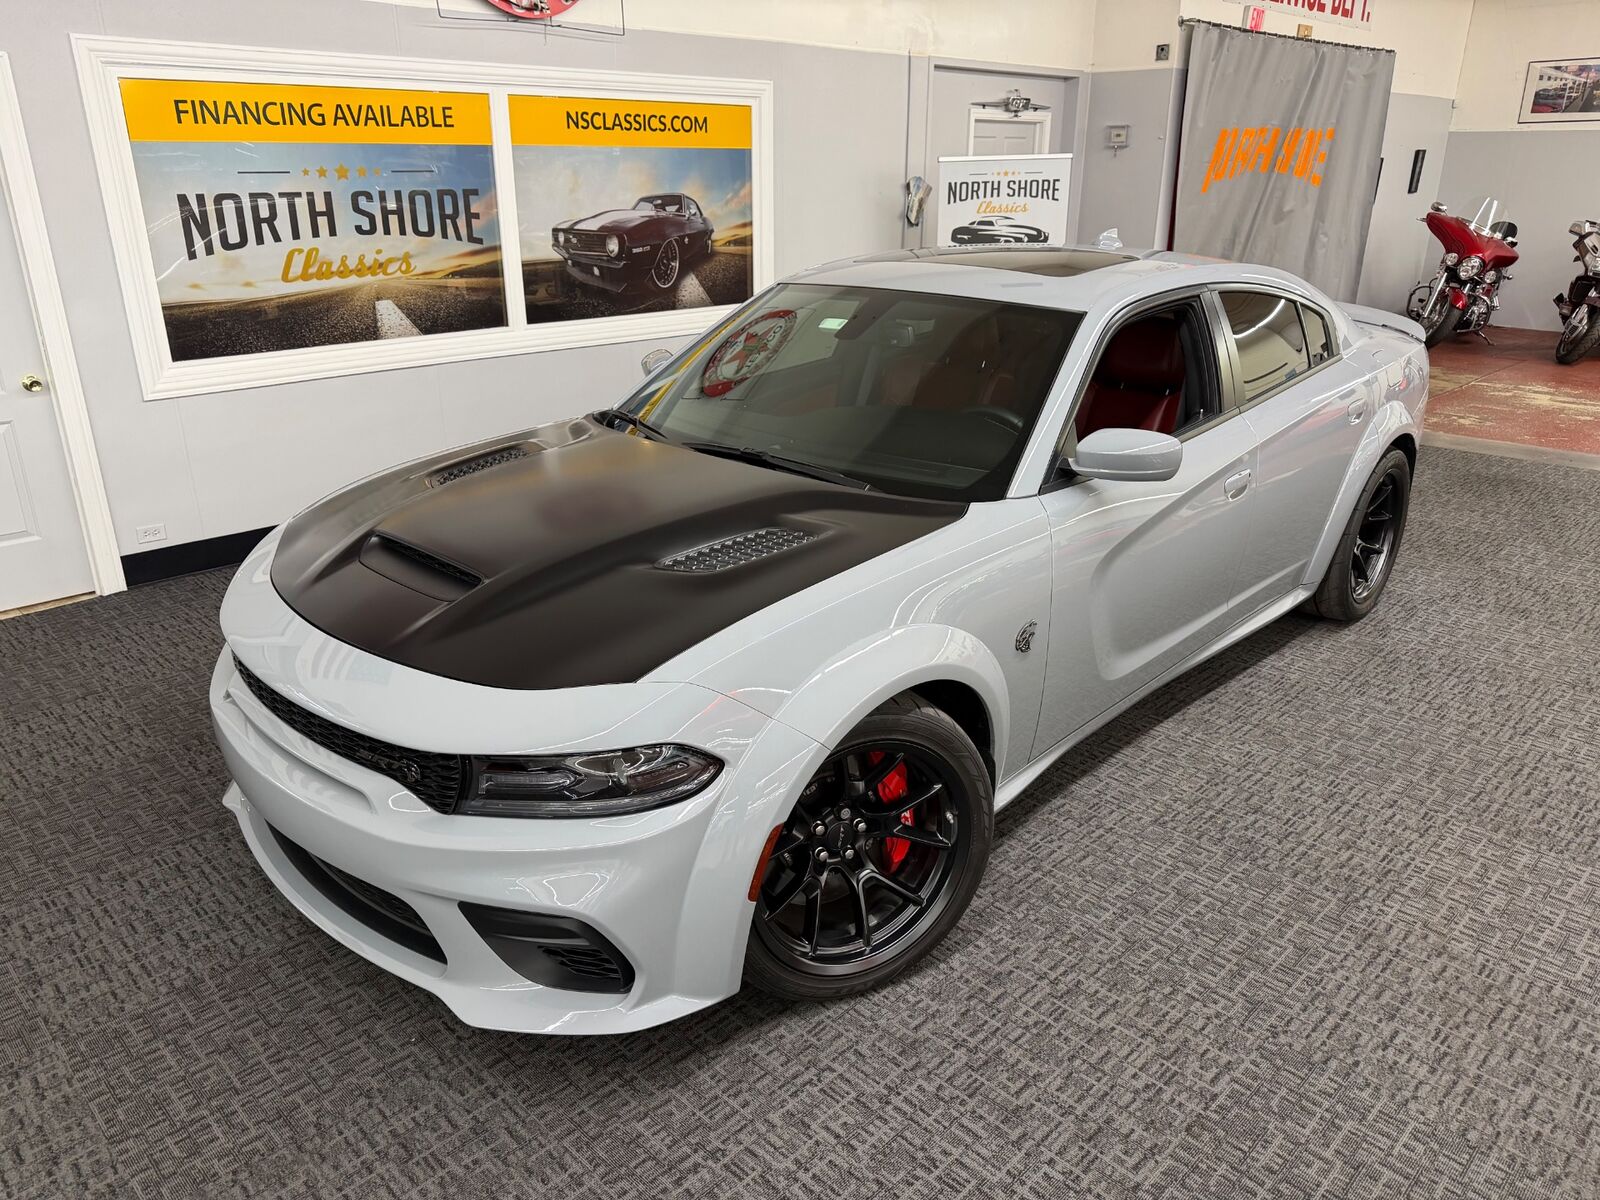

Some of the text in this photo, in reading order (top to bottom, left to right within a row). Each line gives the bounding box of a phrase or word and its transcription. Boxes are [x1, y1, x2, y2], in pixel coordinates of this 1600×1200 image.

[173, 99, 455, 128] FINANCING AVAILABLE
[566, 111, 708, 133] NSCLASSICS.COM
[947, 178, 1061, 205] NORTH SHORE
[976, 200, 1030, 214] Classics
[176, 188, 484, 261] NORTH SHORE
[281, 246, 417, 283] Classics
